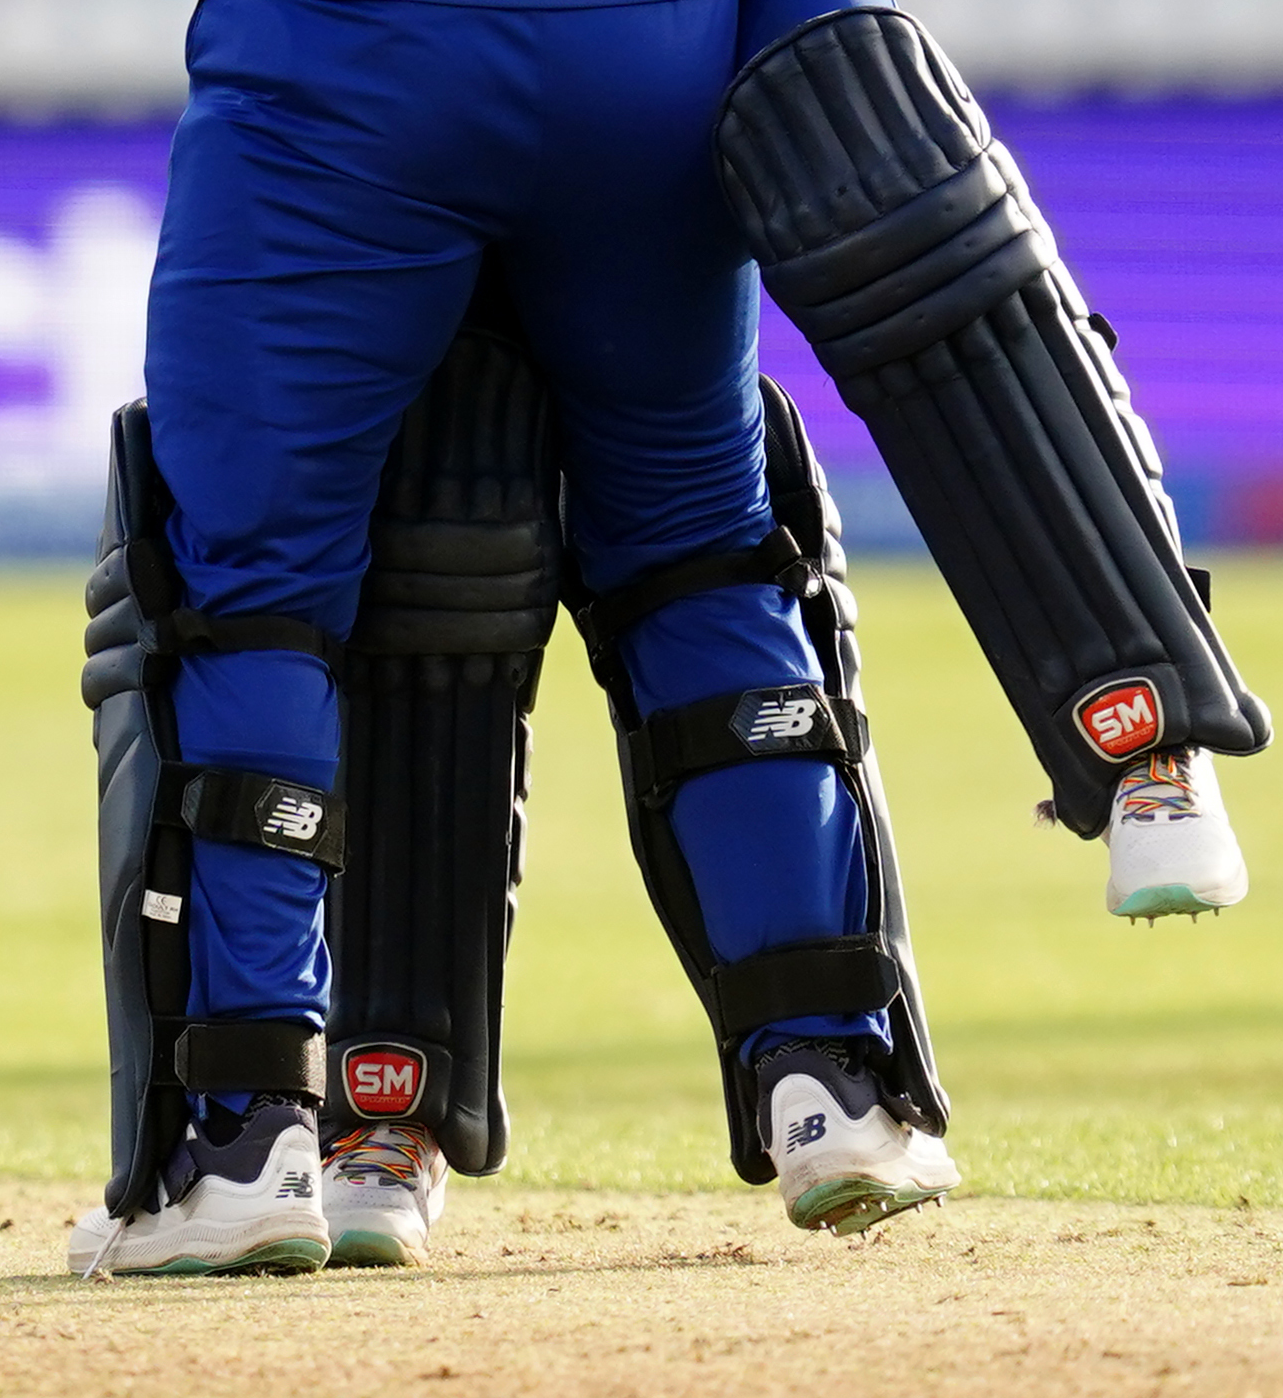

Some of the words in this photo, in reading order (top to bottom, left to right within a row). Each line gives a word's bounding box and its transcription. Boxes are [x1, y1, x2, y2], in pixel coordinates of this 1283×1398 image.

[747, 698, 817, 742] NB
[1091, 694, 1154, 743] SM
[263, 796, 323, 841] NB
[354, 1062, 413, 1095] SM
[786, 1112, 826, 1155] NB
